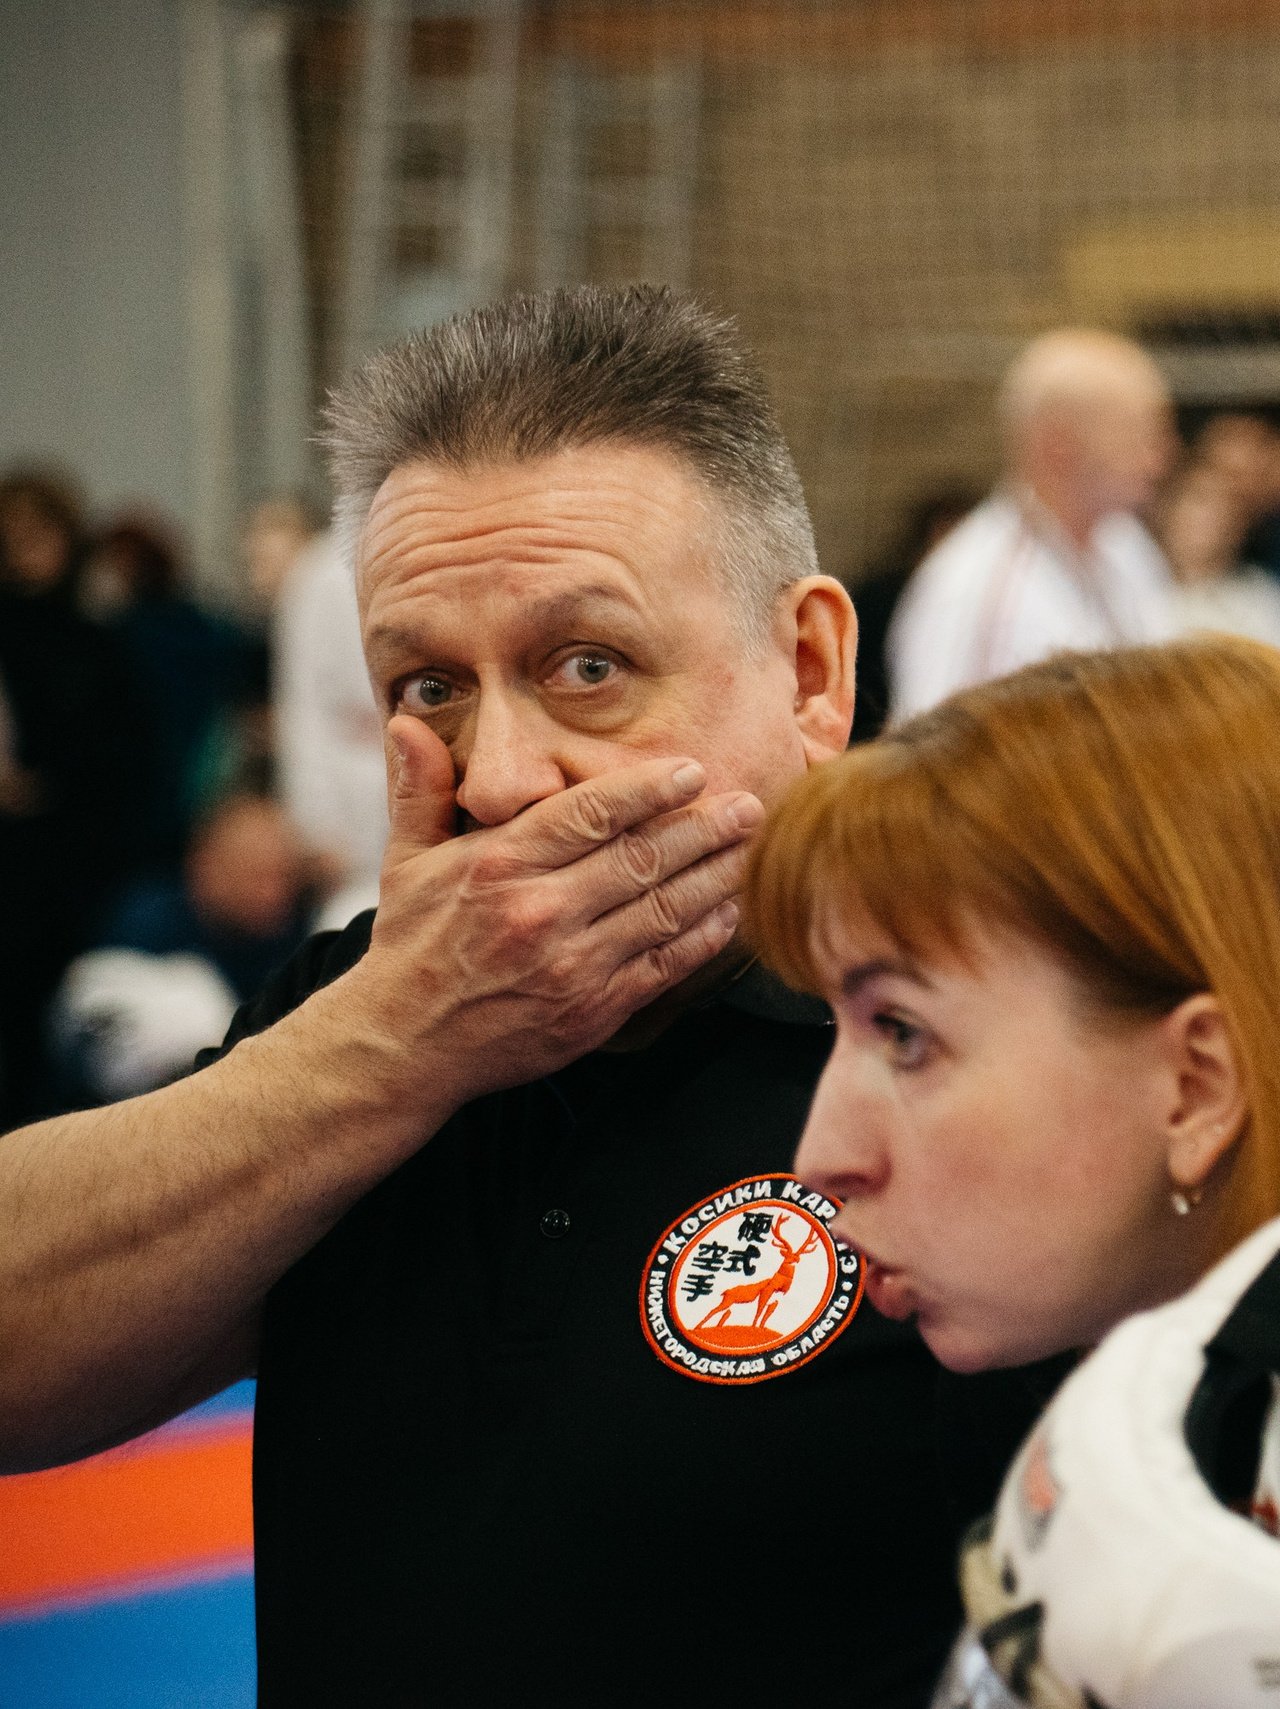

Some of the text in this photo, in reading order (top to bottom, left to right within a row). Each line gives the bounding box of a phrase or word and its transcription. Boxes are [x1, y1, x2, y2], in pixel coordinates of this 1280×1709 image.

[662, 1180, 858, 1274] КОСИКИ КАРЭ
[647, 1270, 850, 1376] НИЖЕГОРОДСКАЯ ОБЛАСТЬ
